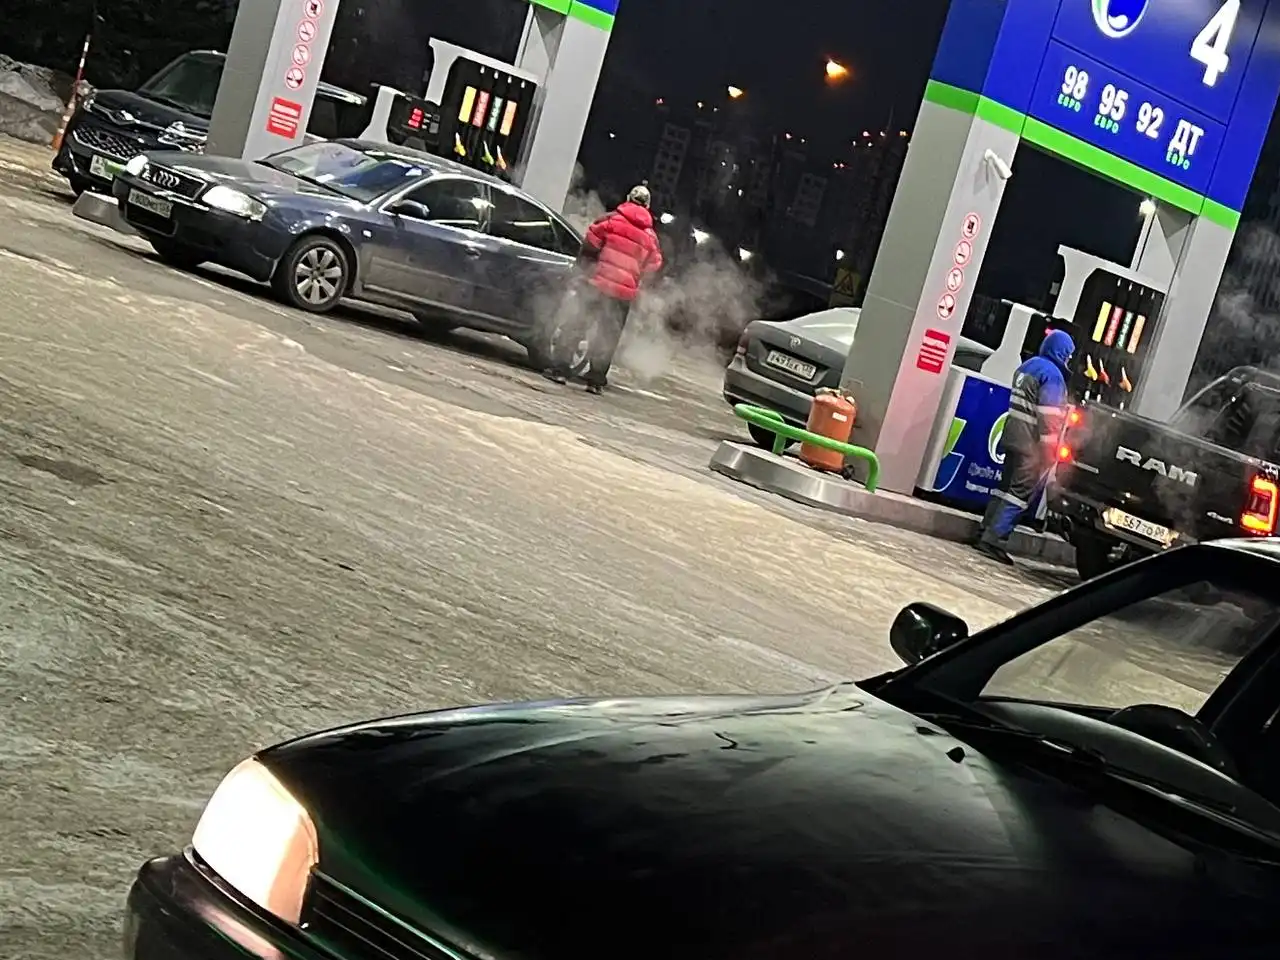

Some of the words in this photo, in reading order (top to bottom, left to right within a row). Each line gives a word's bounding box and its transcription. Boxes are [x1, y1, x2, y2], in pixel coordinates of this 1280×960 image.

[1190, 0, 1241, 87] 4
[1057, 93, 1082, 113] ЕВРО
[1061, 65, 1089, 100] 98
[1098, 83, 1129, 121] 95
[1135, 102, 1164, 139] 92
[1094, 113, 1119, 134] ЕВРО
[1168, 118, 1204, 157] ДТ
[1115, 446, 1197, 487] RAM
